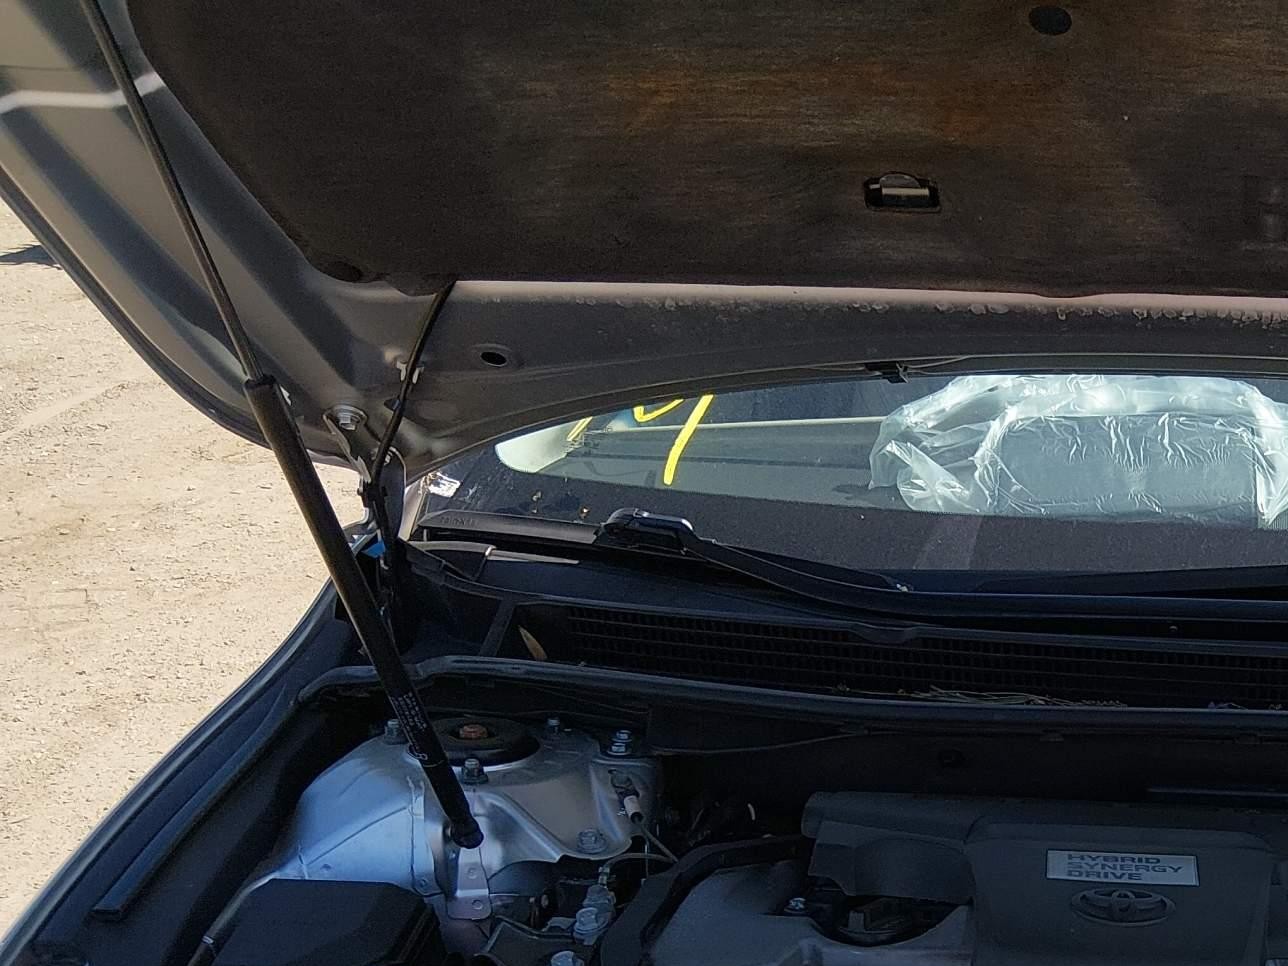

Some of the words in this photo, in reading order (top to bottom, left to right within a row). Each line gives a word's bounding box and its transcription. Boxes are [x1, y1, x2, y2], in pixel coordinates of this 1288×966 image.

[1066, 853, 1161, 865] HYBRID
[1066, 861, 1184, 873] SYNERGY
[1066, 869, 1143, 881] DRIVE
